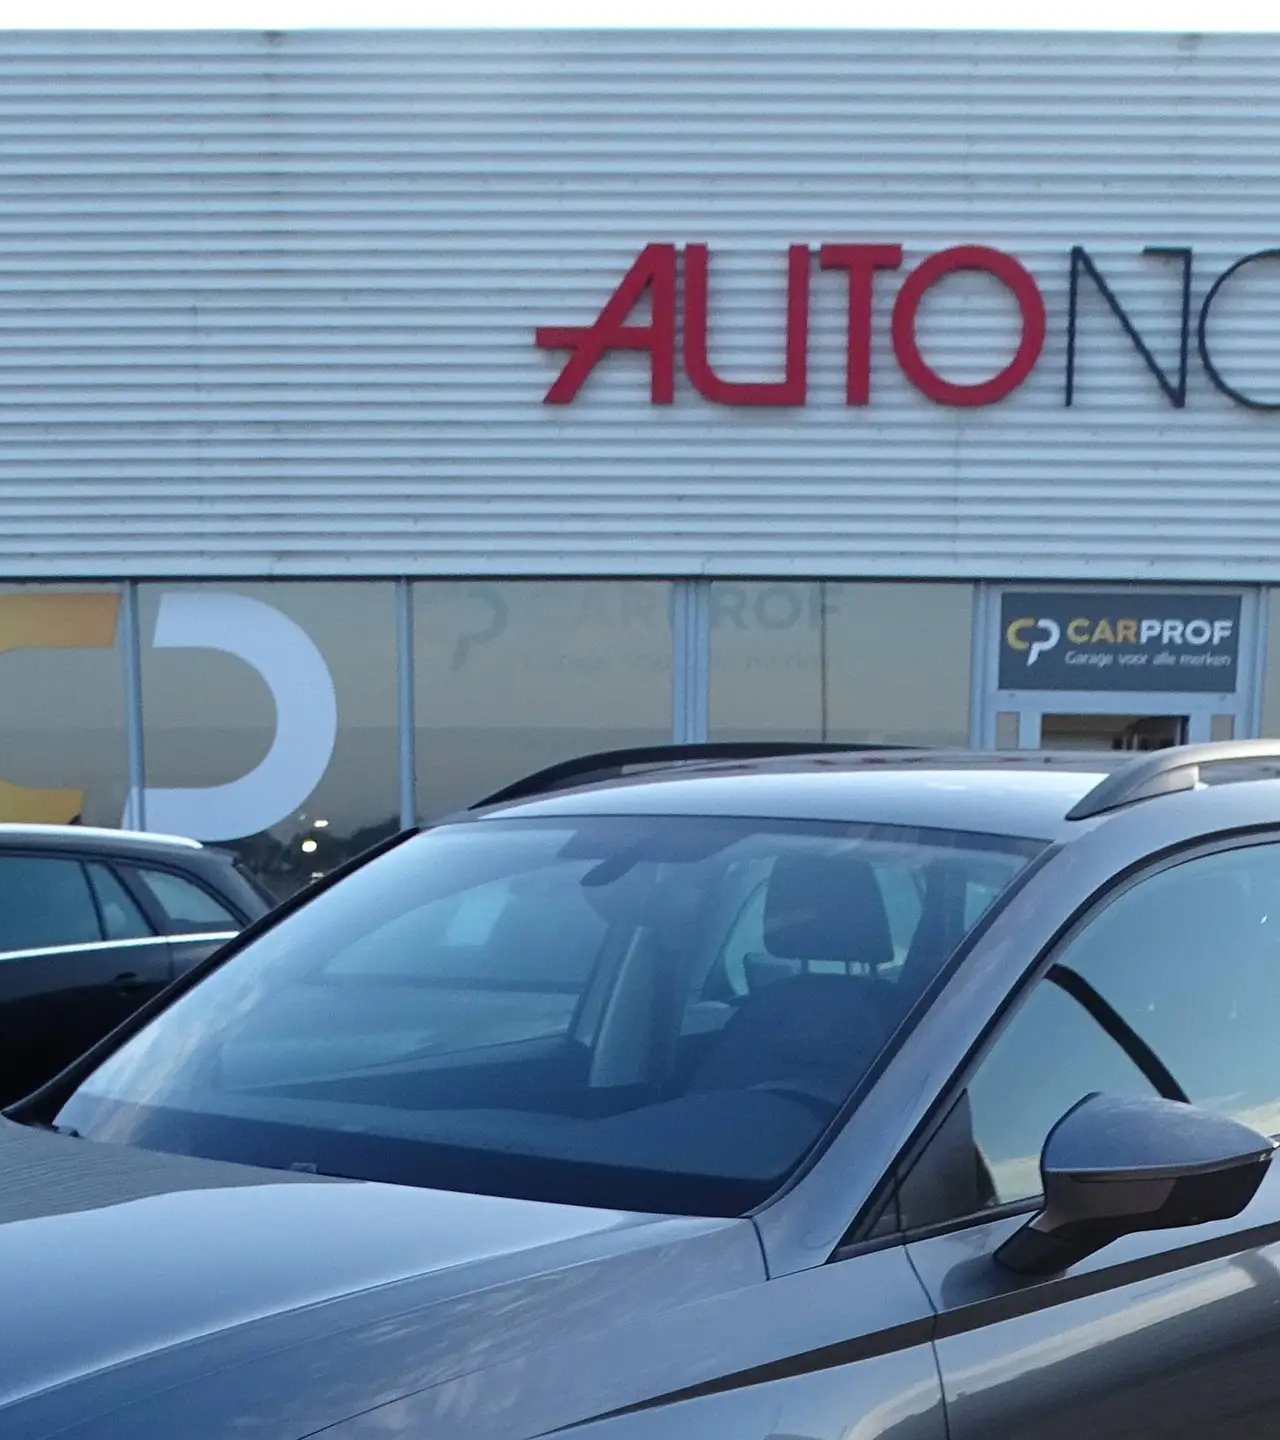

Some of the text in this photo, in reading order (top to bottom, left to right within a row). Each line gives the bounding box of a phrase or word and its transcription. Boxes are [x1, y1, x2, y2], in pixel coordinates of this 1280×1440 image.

[1065, 617, 1234, 646] CARPROF
[1064, 651, 1232, 668] Garage voor alle merken
